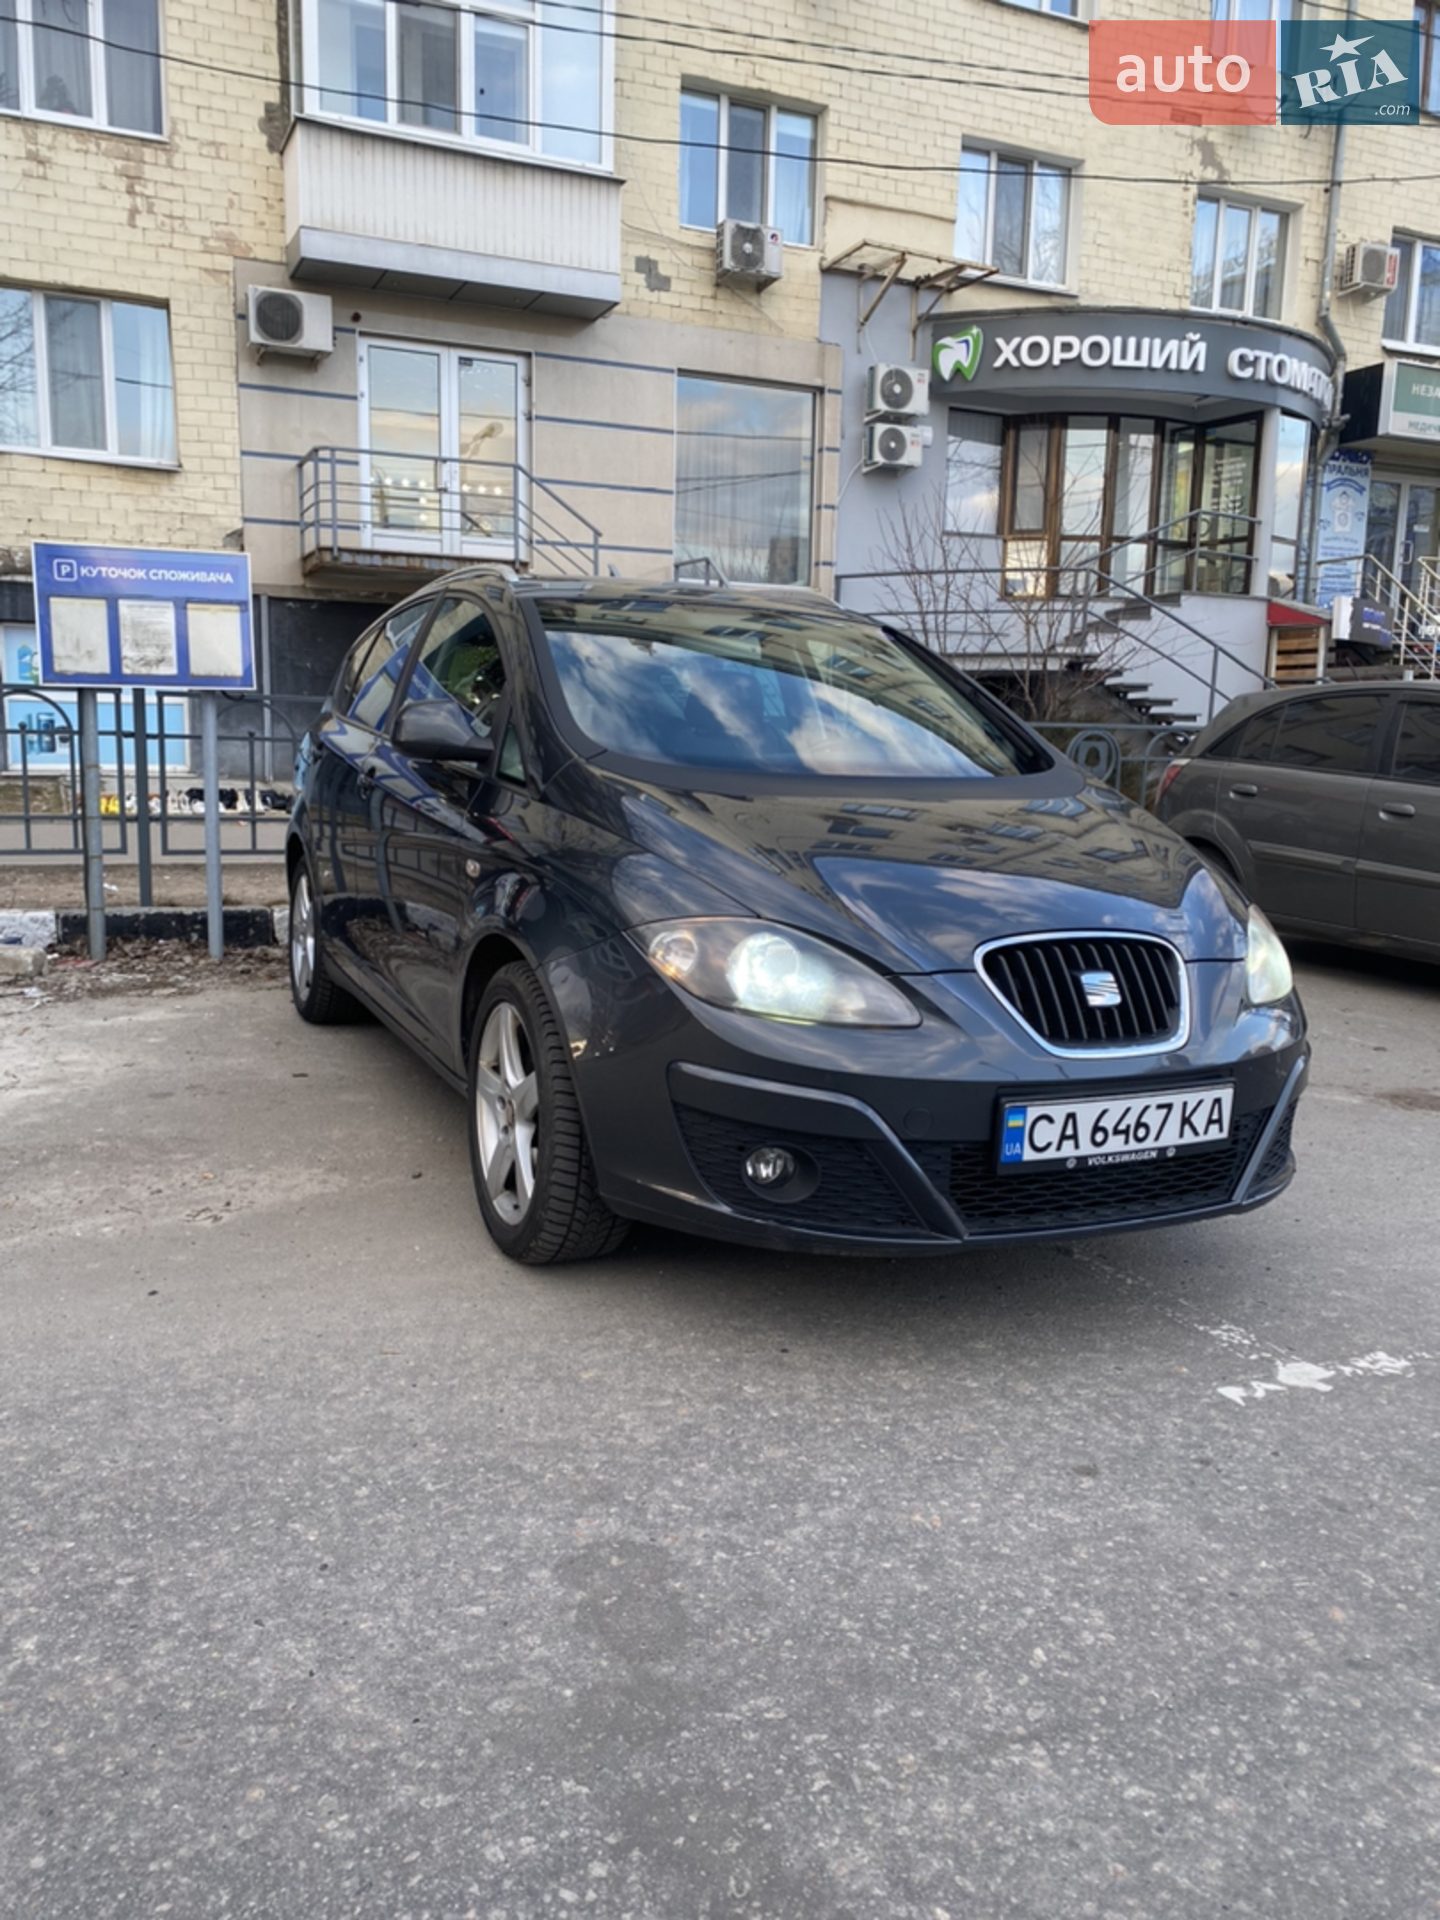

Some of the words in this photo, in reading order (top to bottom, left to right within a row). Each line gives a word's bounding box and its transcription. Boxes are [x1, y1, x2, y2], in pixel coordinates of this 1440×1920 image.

[992, 331, 1208, 373] ХОРОШИЙ
[80, 565, 147, 581] КУТОЧОК
[148, 568, 234, 584] СПОЖИВАЧА
[1028, 1111, 1080, 1153] CA
[1089, 1103, 1174, 1148] 6467
[1178, 1097, 1224, 1139] KA
[1005, 1142, 1021, 1156] UA
[1087, 1149, 1158, 1166] VOLKSWAGEN
